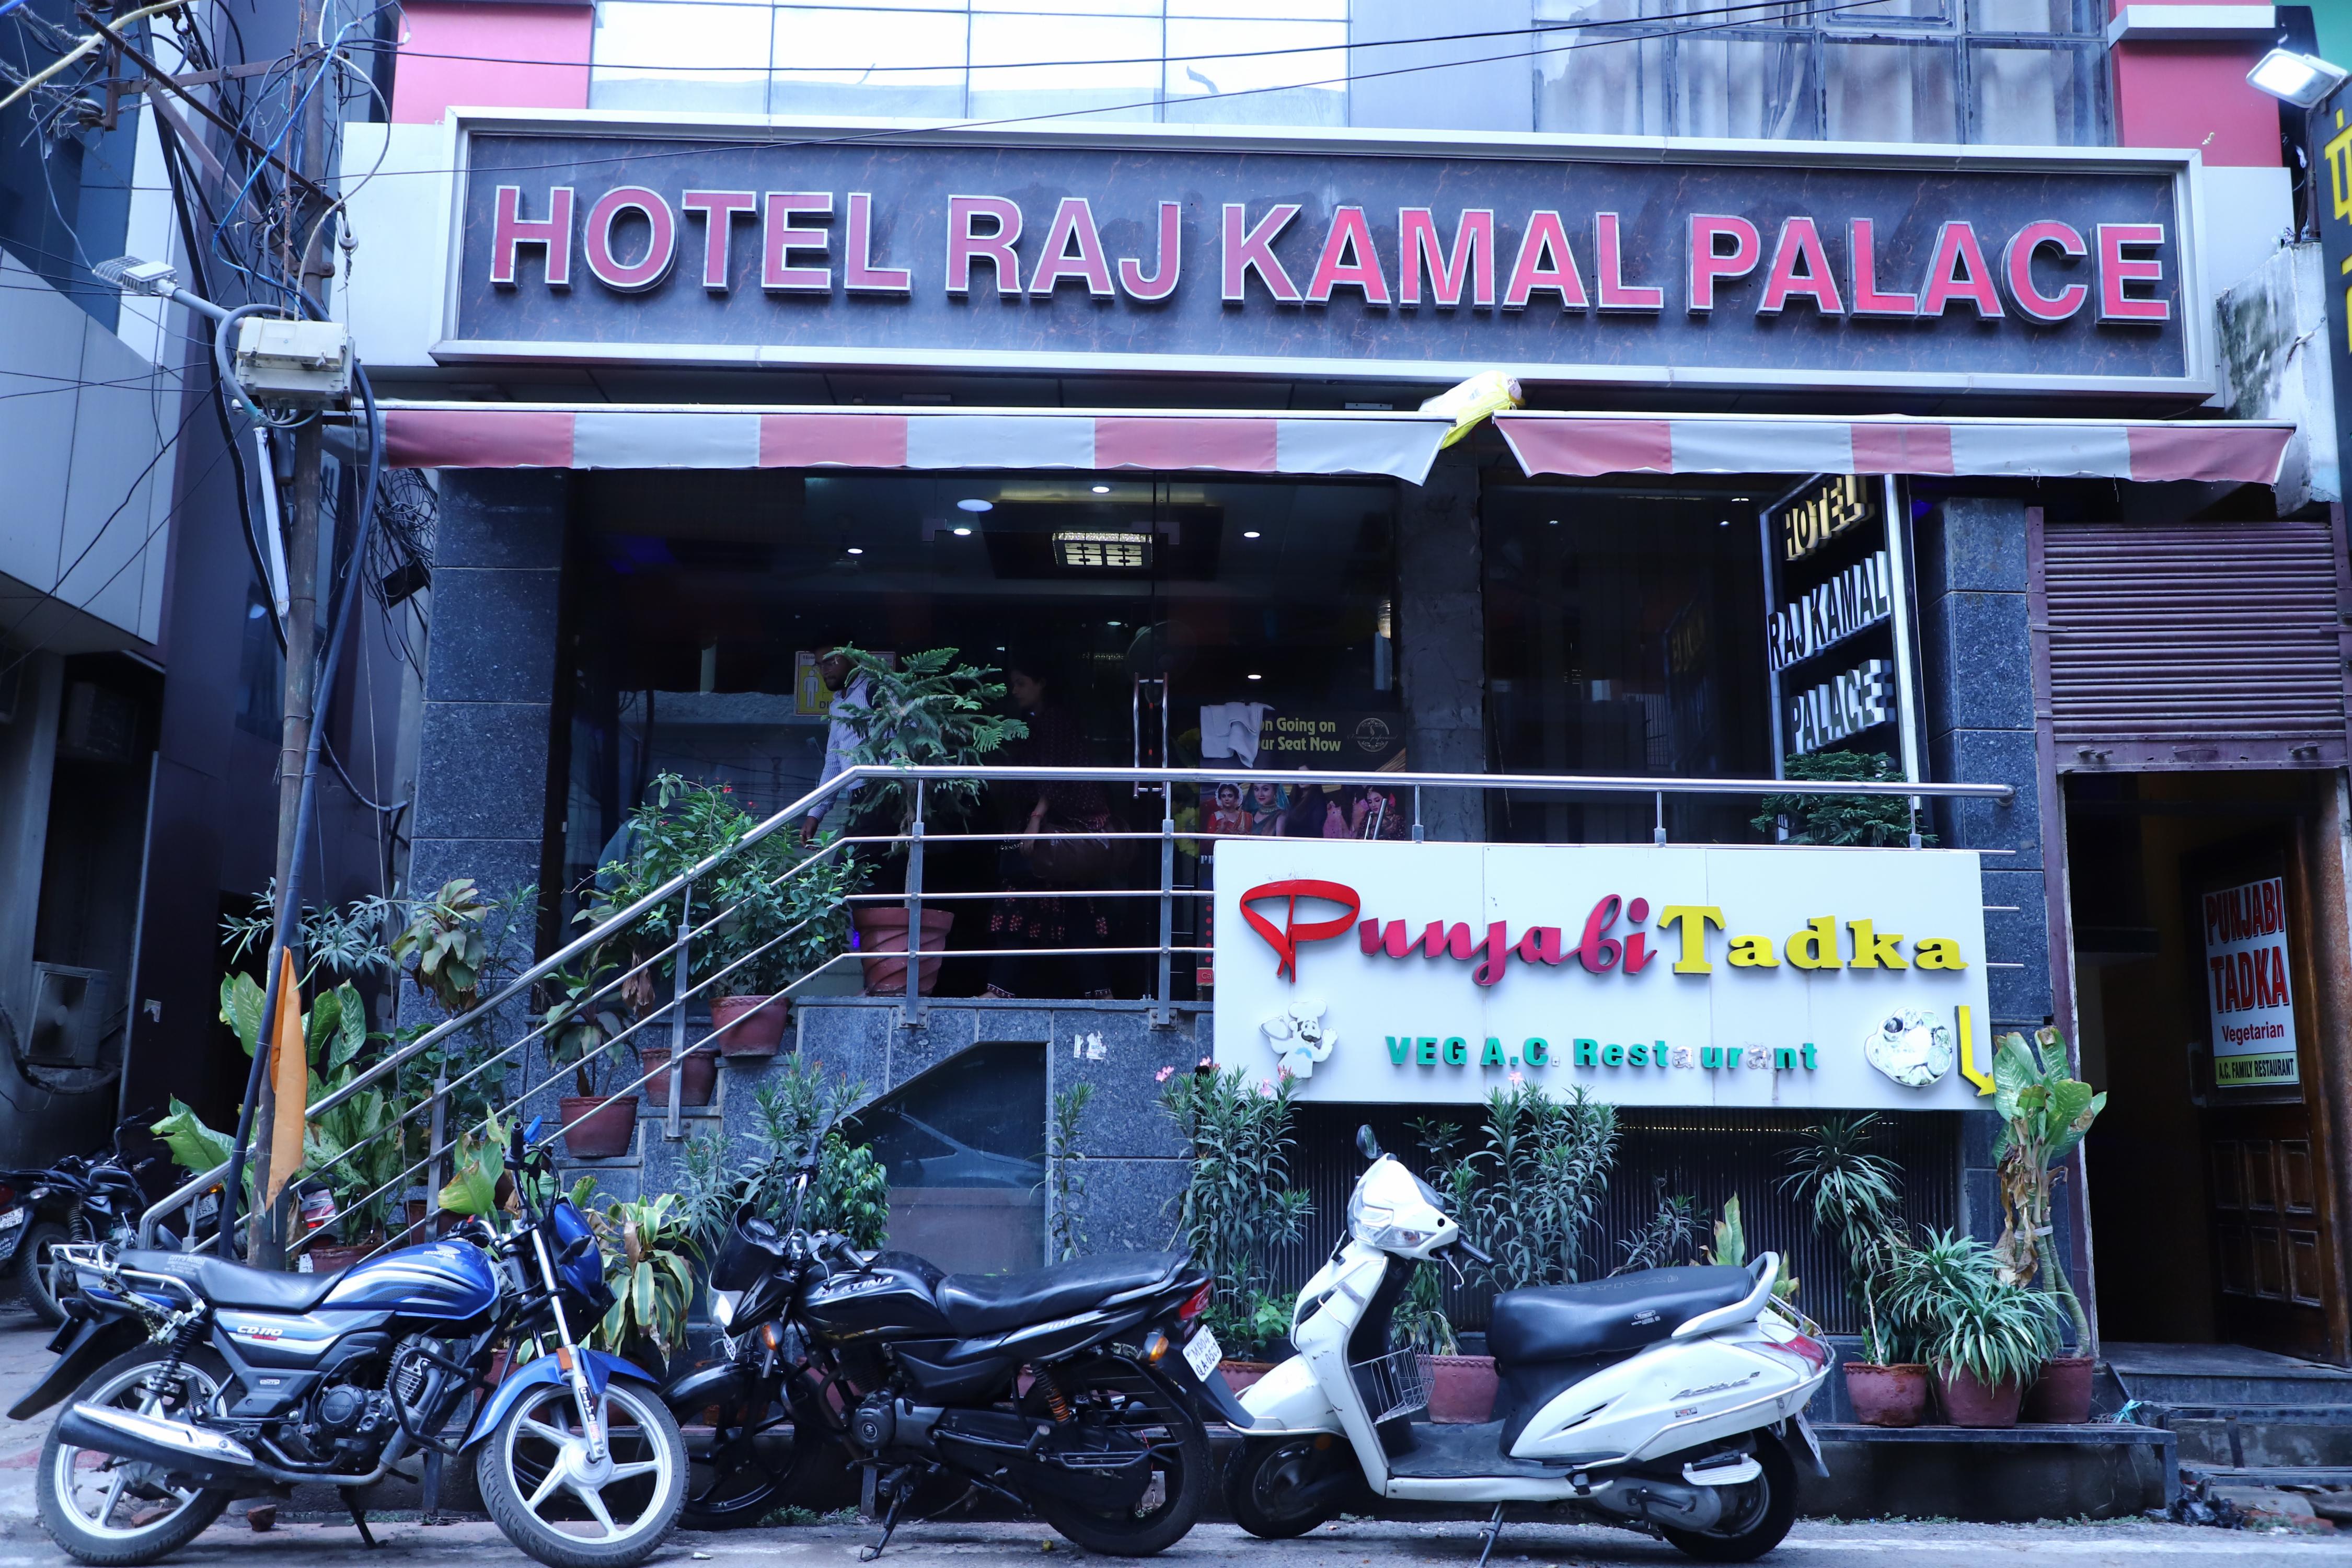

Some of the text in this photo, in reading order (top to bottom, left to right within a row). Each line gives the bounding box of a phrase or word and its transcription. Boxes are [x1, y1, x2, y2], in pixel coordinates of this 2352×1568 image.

[489, 185, 2171, 325] HOTEL RAJ KAMAL PALACE
[1783, 475, 1866, 560] HOTEL
[1790, 659, 1888, 754] PALACE
[1276, 717, 1316, 735] Going
[1319, 721, 1336, 732] on
[1259, 739, 1274, 751] ur
[1277, 736, 1307, 751] Seat
[1310, 737, 1342, 752] Now
[2205, 879, 2285, 945] PUNJABI
[1240, 879, 1969, 986] Punjabi Tadka
[2209, 946, 2290, 1013] TADKA
[2222, 1021, 2285, 1046] Vegetarian
[1385, 1036, 1468, 1065] VEG
[1573, 1038, 1818, 1070] Restaurant
[2219, 1058, 2294, 1079] A.C. FAMILY RESTAURANT
[816, 1276, 894, 1300] PLATINA
[1669, 1377, 1750, 1401] Activa
